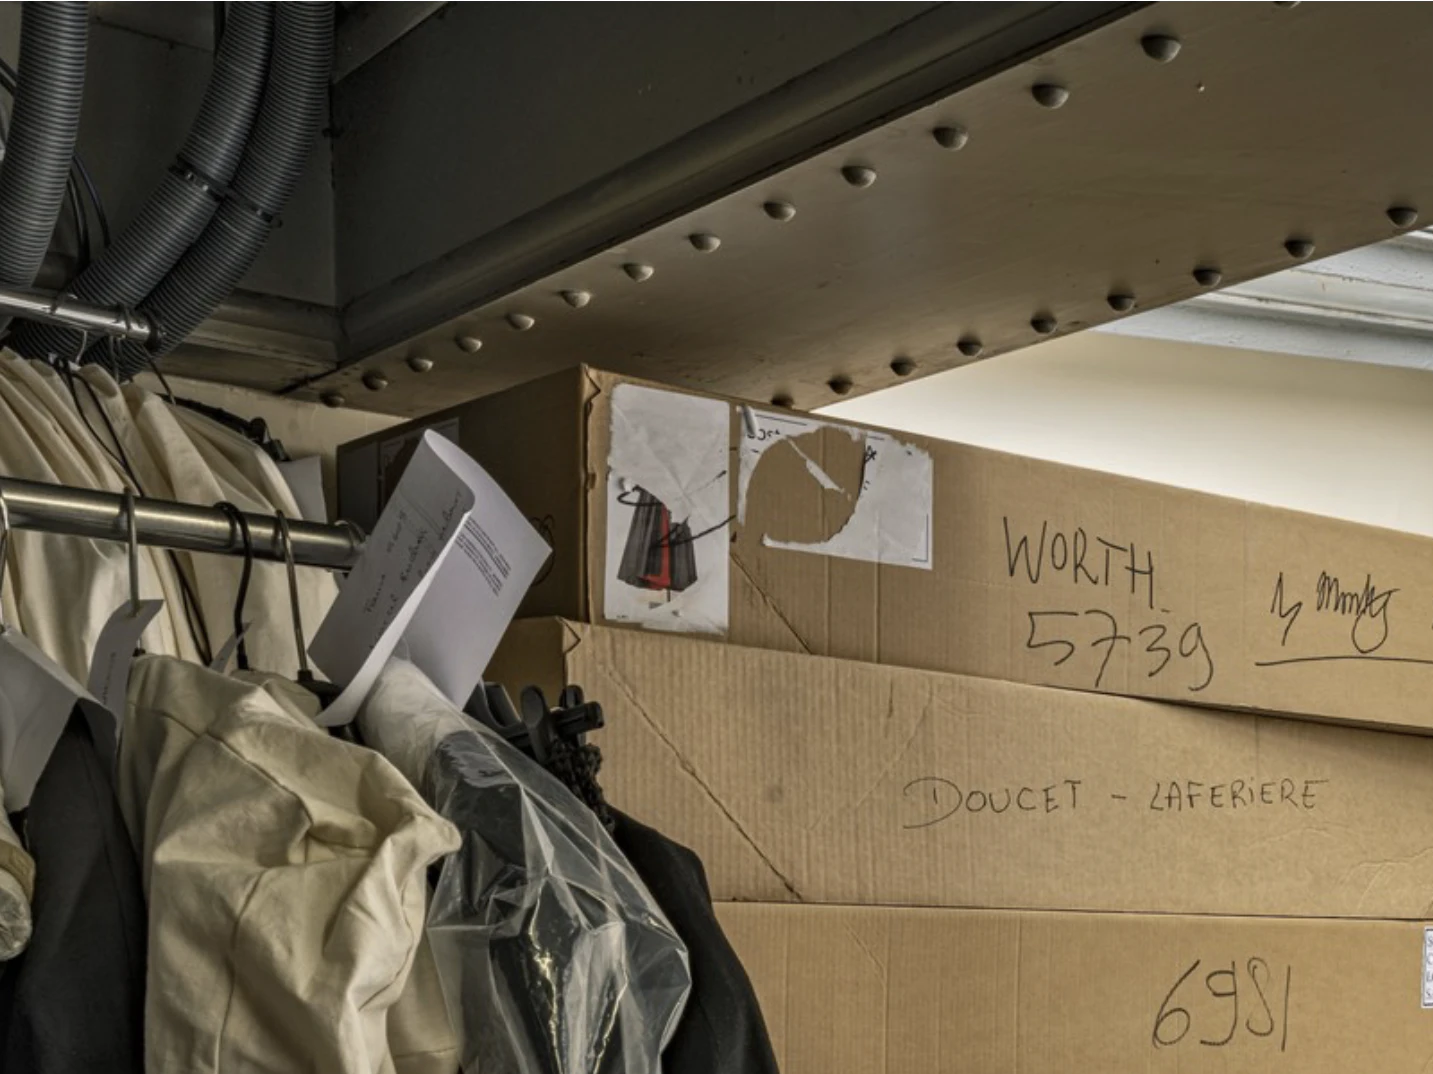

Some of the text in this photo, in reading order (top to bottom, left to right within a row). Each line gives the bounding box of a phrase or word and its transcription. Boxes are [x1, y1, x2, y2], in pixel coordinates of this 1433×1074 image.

[1003, 515, 1154, 610] WORTH
[1026, 608, 1214, 692] 5739
[902, 775, 1082, 830] DOUCET
[1151, 956, 1292, 1053] 6981
